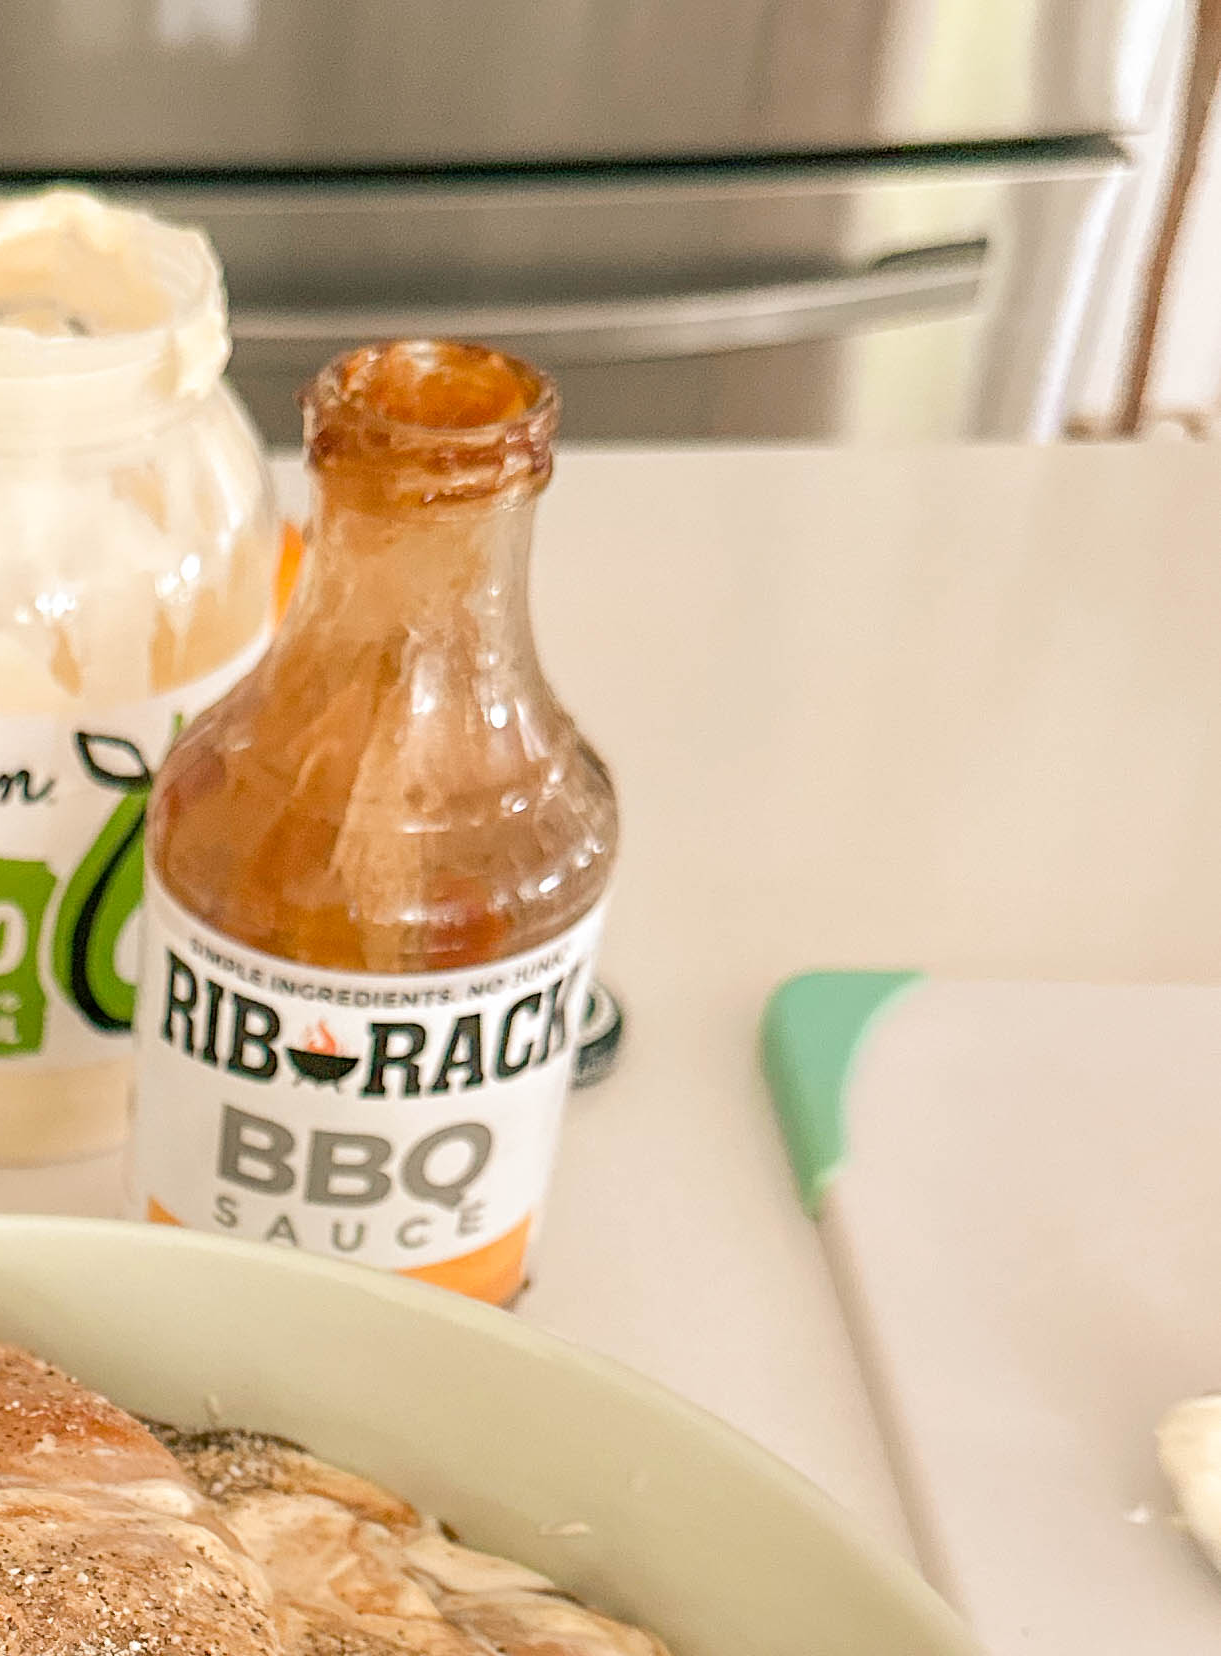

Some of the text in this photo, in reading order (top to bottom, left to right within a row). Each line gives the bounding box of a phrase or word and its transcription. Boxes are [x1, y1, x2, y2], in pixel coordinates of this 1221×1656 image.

[189, 937, 264, 984] SIMPLE
[162, 948, 585, 1099] RIB RACK
[217, 1104, 493, 1213] BBQ
[213, 1195, 486, 1253] SAUCE
